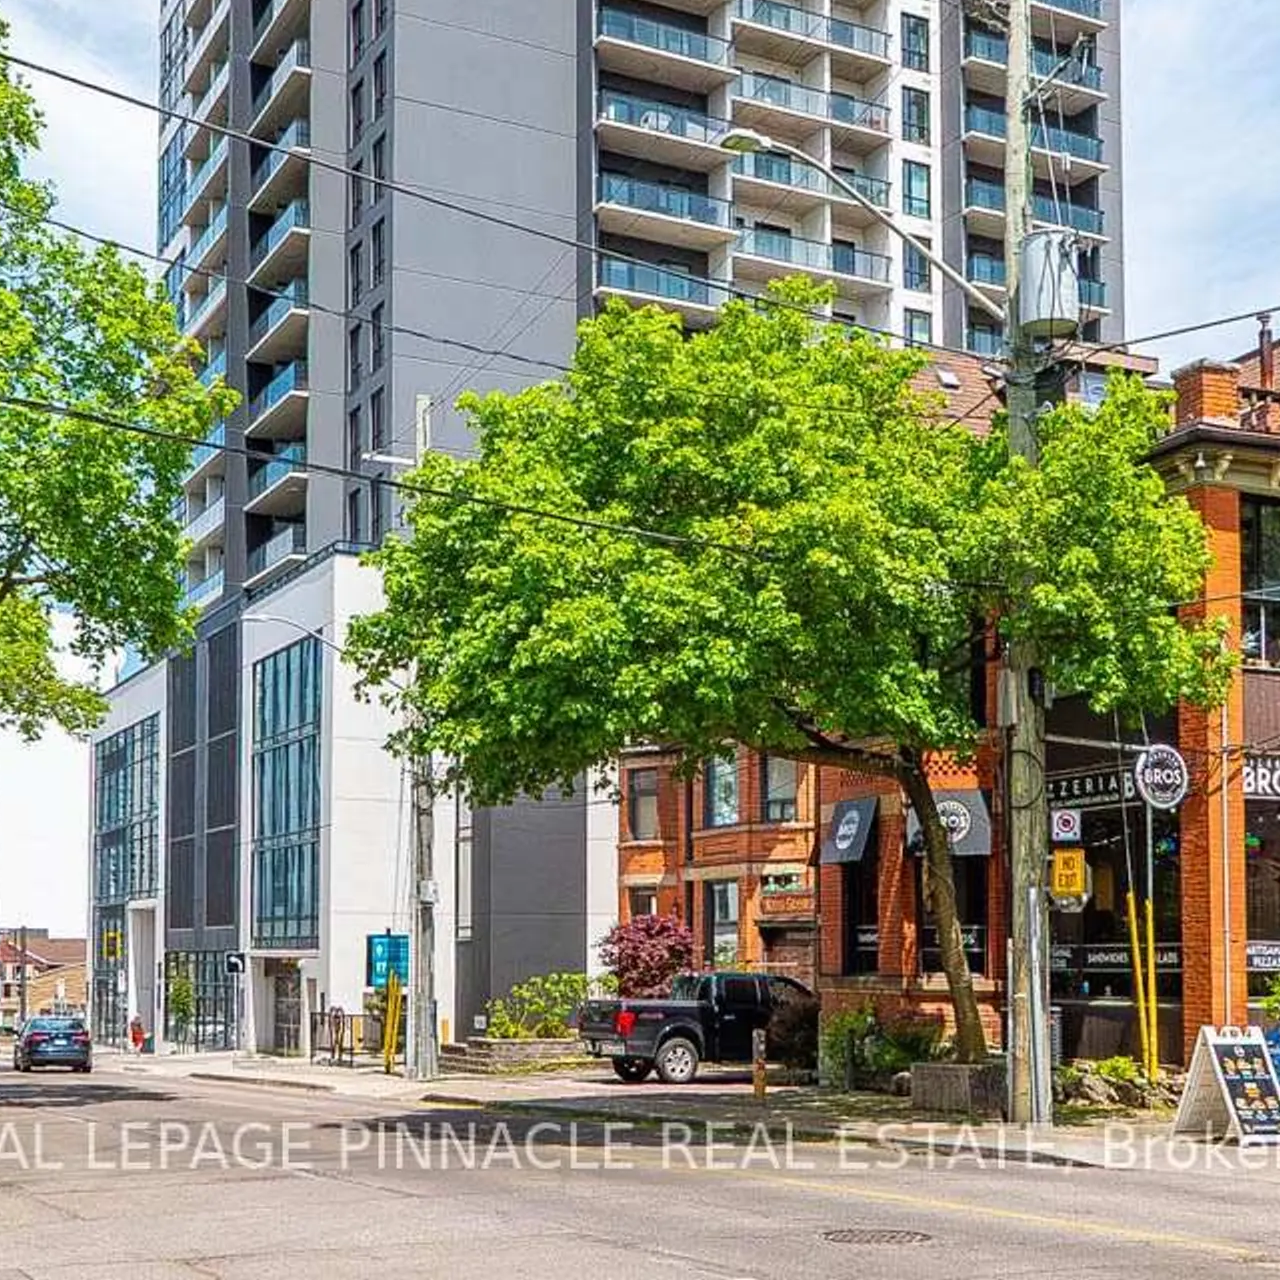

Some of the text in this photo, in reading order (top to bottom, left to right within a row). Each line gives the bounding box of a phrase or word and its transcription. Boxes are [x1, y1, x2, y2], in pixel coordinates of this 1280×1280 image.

[1143, 768, 1181, 785] BROS
[1062, 856, 1076, 870] NO
[1058, 873, 1077, 887] EXIT
